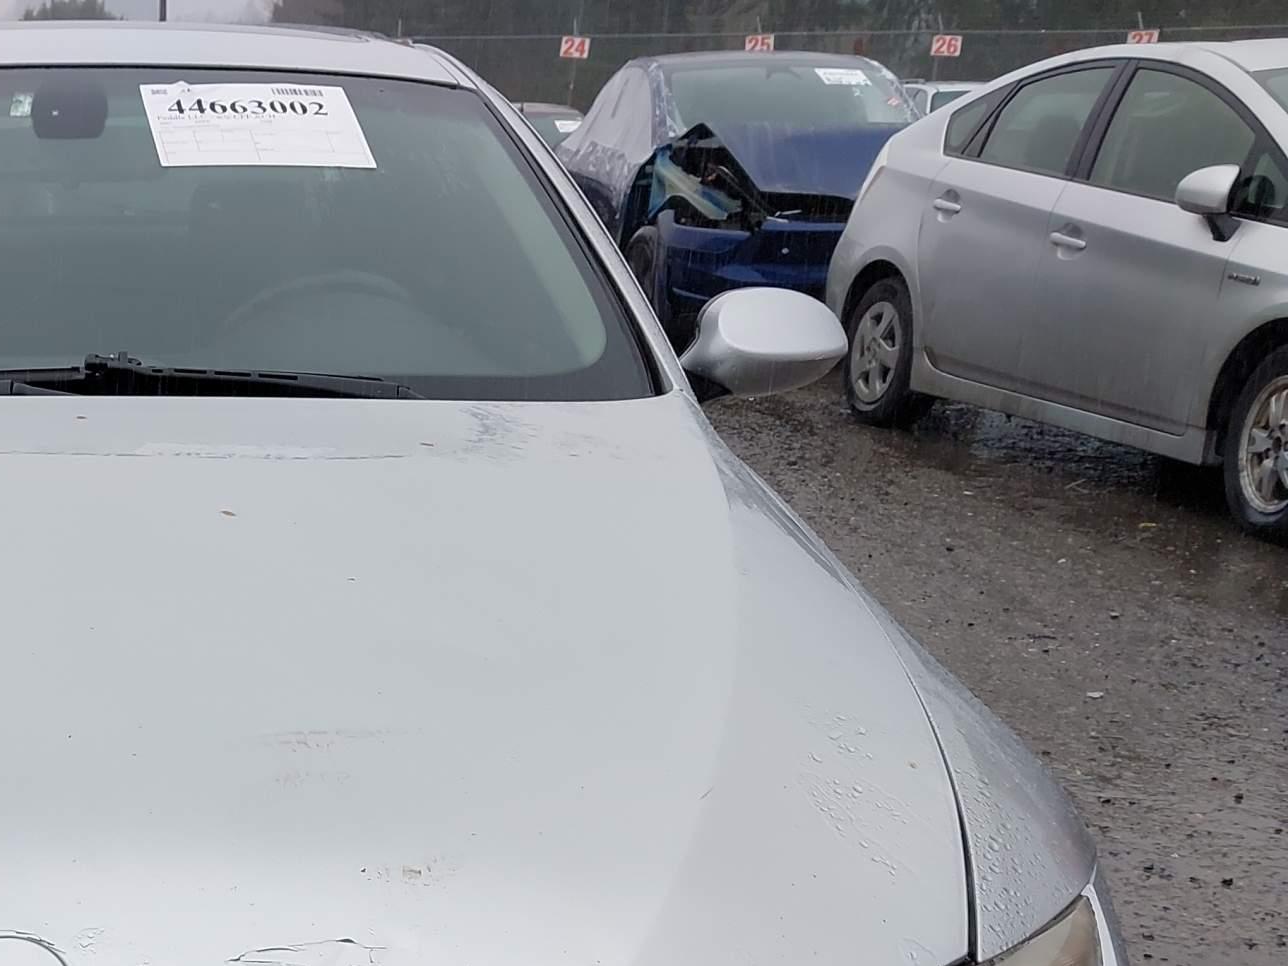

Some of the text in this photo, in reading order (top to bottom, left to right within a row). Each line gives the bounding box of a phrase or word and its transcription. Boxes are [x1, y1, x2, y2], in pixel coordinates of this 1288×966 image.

[748, 36, 771, 50] 25
[934, 37, 958, 54] 26
[1131, 32, 1155, 43] 27
[564, 38, 586, 56] 24
[167, 98, 328, 116] 44663002
